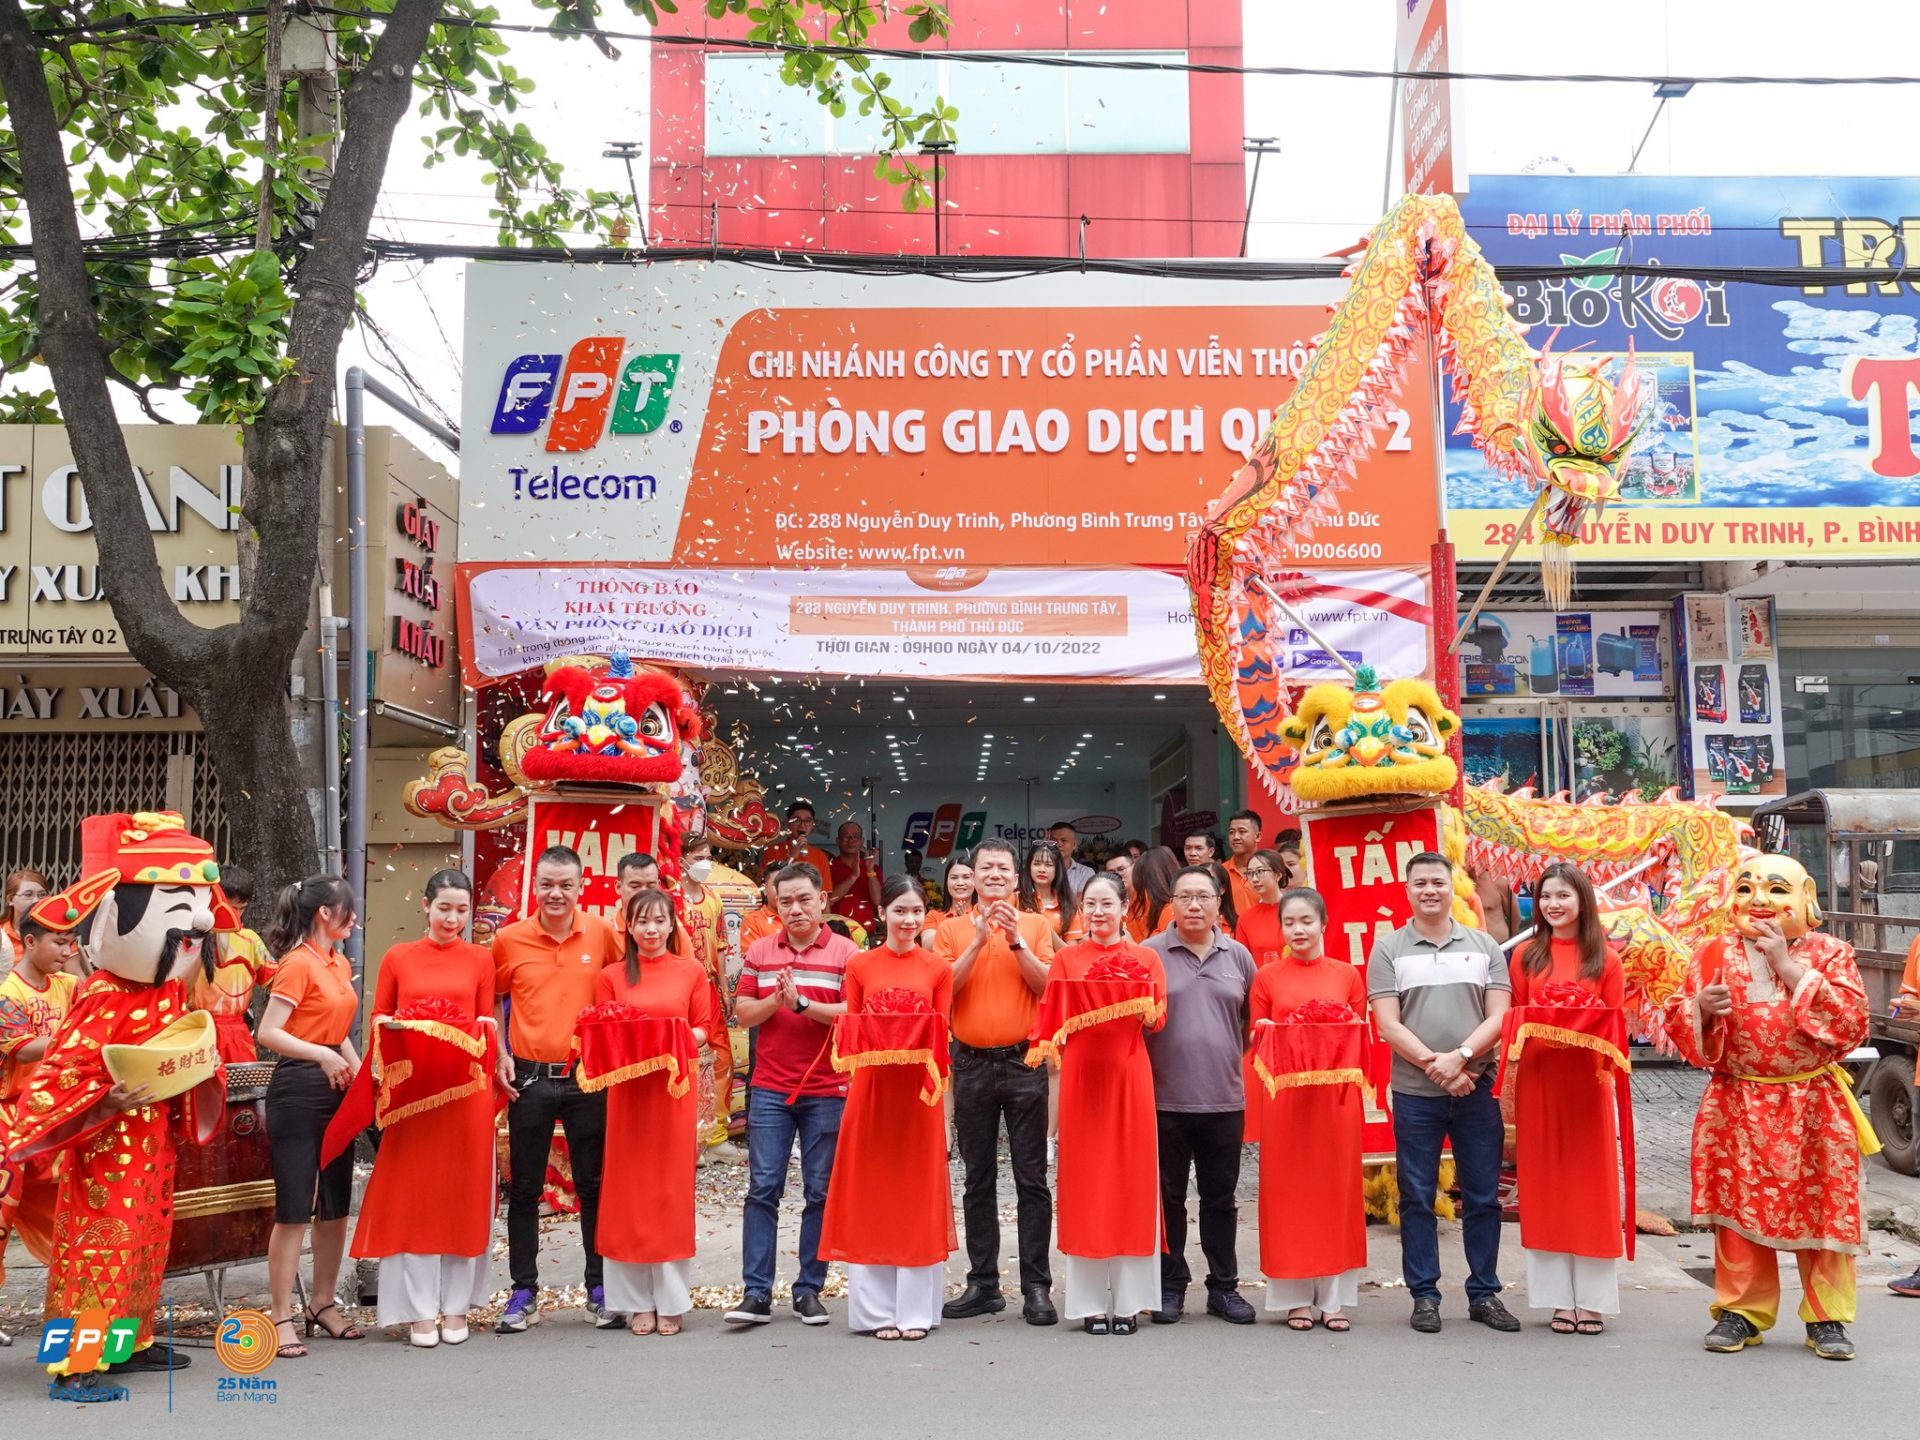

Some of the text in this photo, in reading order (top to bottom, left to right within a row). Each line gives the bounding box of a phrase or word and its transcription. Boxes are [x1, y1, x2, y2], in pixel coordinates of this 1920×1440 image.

[1507, 207, 1712, 239] ĐẠI LÝ PHÂN PHỐI
[748, 349, 794, 378] CHI
[802, 343, 905, 378] NHÁNH
[914, 342, 989, 378] CÔNG
[997, 349, 1034, 377] TY
[1041, 333, 1076, 377] CỔ
[1085, 334, 1168, 377] PHẦN
[1176, 334, 1242, 376] VIỄN
[747, 396, 926, 454] PHÒNG
[942, 408, 1070, 453] GIAO
[1088, 408, 1204, 463] DỊCH
[1385, 409, 1412, 453] 2
[509, 466, 657, 501] Telecom
[775, 513, 803, 529] ĐC:
[807, 513, 842, 529] 288
[846, 510, 914, 532] Nguyễn
[918, 513, 951, 532] Duy
[956, 512, 1005, 531] Trinh,
[1011, 511, 1077, 532] Phường
[1081, 511, 1120, 528] Bình
[1124, 512, 1173, 532] Trưng
[1347, 511, 1380, 527] Đức
[1662, 522, 1715, 544] DUY
[1724, 522, 1814, 548] TRINH,
[1824, 521, 1849, 543] P.
[1858, 516, 1920, 543] BÌNH
[776, 544, 853, 560] Website:
[858, 544, 965, 562] www.fpt.vn
[1294, 543, 1382, 559] 19006600
[576, 577, 699, 596] THÔNG BÁO
[565, 601, 615, 615] KHAI
[796, 601, 821, 615] 288
[825, 598, 877, 615] NGUYỄN
[880, 602, 905, 615] DUY
[955, 600, 1008, 615] PHƯỜNG
[1011, 600, 1042, 615] BÌNH
[1046, 602, 1088, 615] TRƯNG
[1092, 600, 1121, 616] TÂY,
[892, 617, 1024, 633] THÀNH PHỐ THỦ ĐỨC
[1309, 609, 1389, 625] www.fpt.vn
[57, 625, 87, 644] TÂY
[92, 628, 105, 644] Q
[107, 628, 117, 644] 2
[515, 615, 752, 640] VĂN PHÒNG GIAO DỊCH
[816, 640, 850, 654] THỜI
[854, 641, 890, 653] GIAN
[902, 641, 953, 654] 09H00
[957, 639, 998, 654] NGÀY
[1002, 641, 1101, 655] 04/10/2022
[995, 823, 1047, 840] Teleco
[1334, 821, 1426, 889] TẤN
